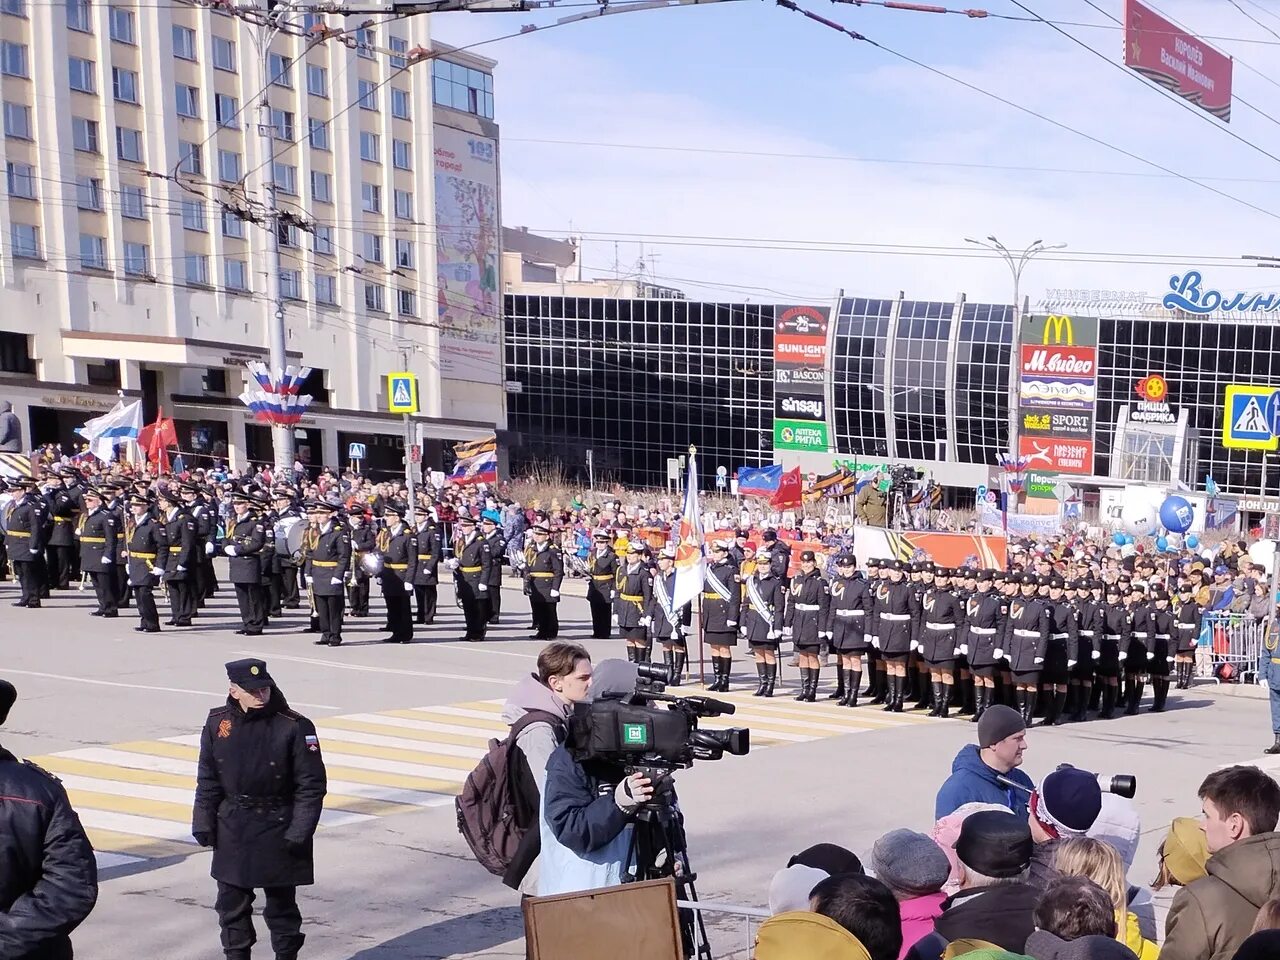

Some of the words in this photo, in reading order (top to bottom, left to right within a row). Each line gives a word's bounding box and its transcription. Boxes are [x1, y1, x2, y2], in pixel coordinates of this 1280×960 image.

[777, 343, 826, 354] SUNLIGHT
[1024, 350, 1093, 373] М.видео
[793, 371, 824, 380] BASCON
[781, 397, 822, 417] sinsay
[1137, 402, 1170, 412] ПИЦЦА
[1052, 415, 1089, 426] SPORT
[1131, 411, 1176, 422] ФАБРИКА
[795, 428, 822, 437] АПТЕКА
[795, 435, 822, 446] РИГЛА
